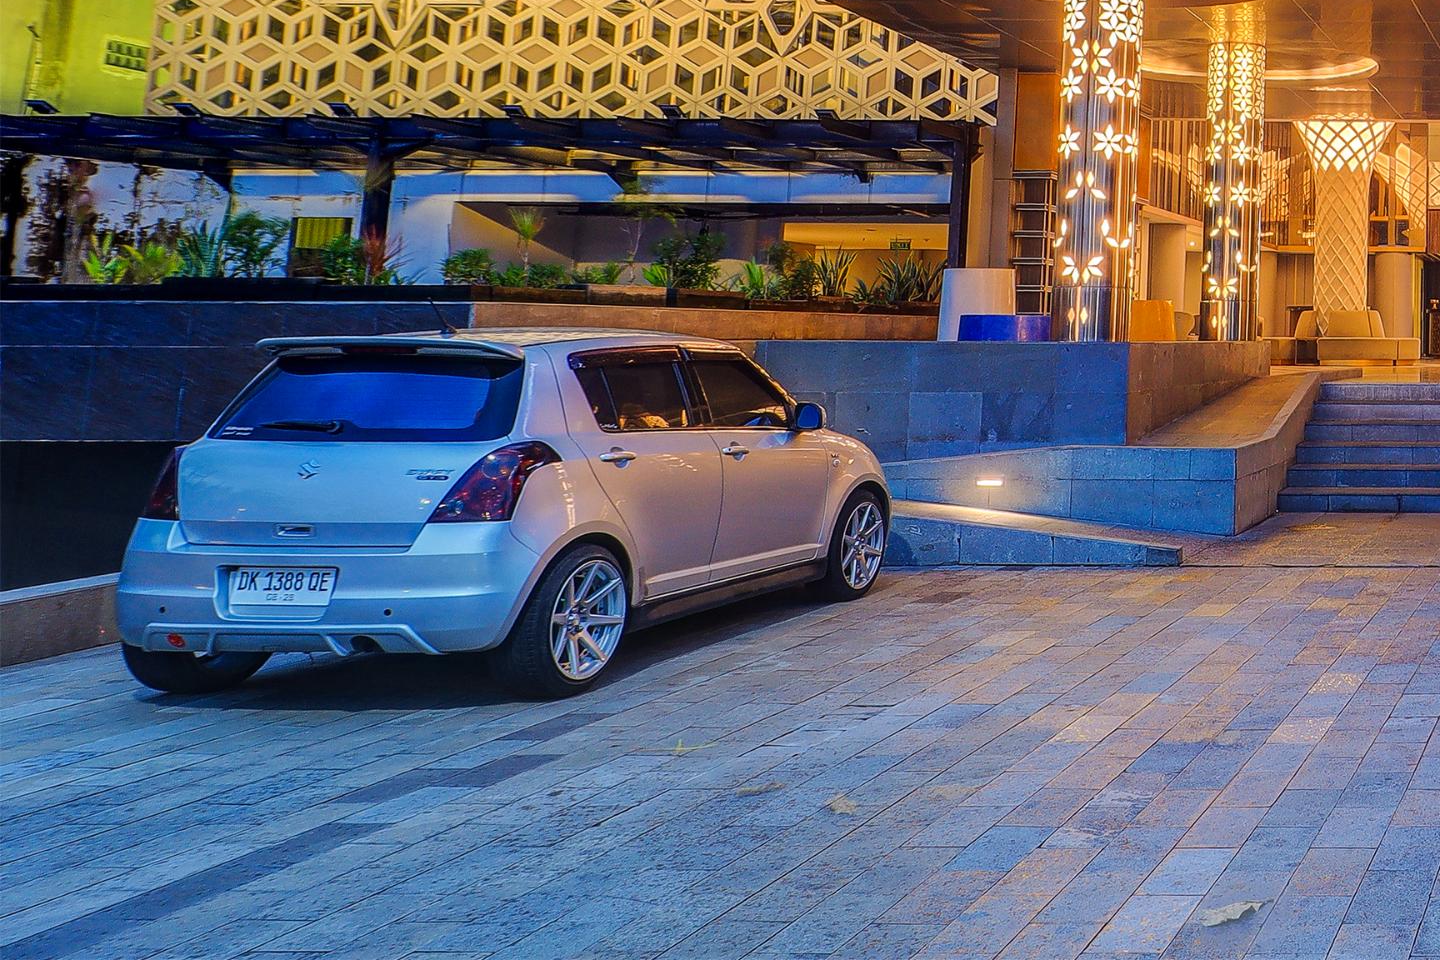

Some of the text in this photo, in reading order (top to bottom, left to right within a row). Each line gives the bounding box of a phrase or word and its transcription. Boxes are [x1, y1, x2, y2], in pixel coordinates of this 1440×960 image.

[237, 571, 331, 592] DK 1388 QE
